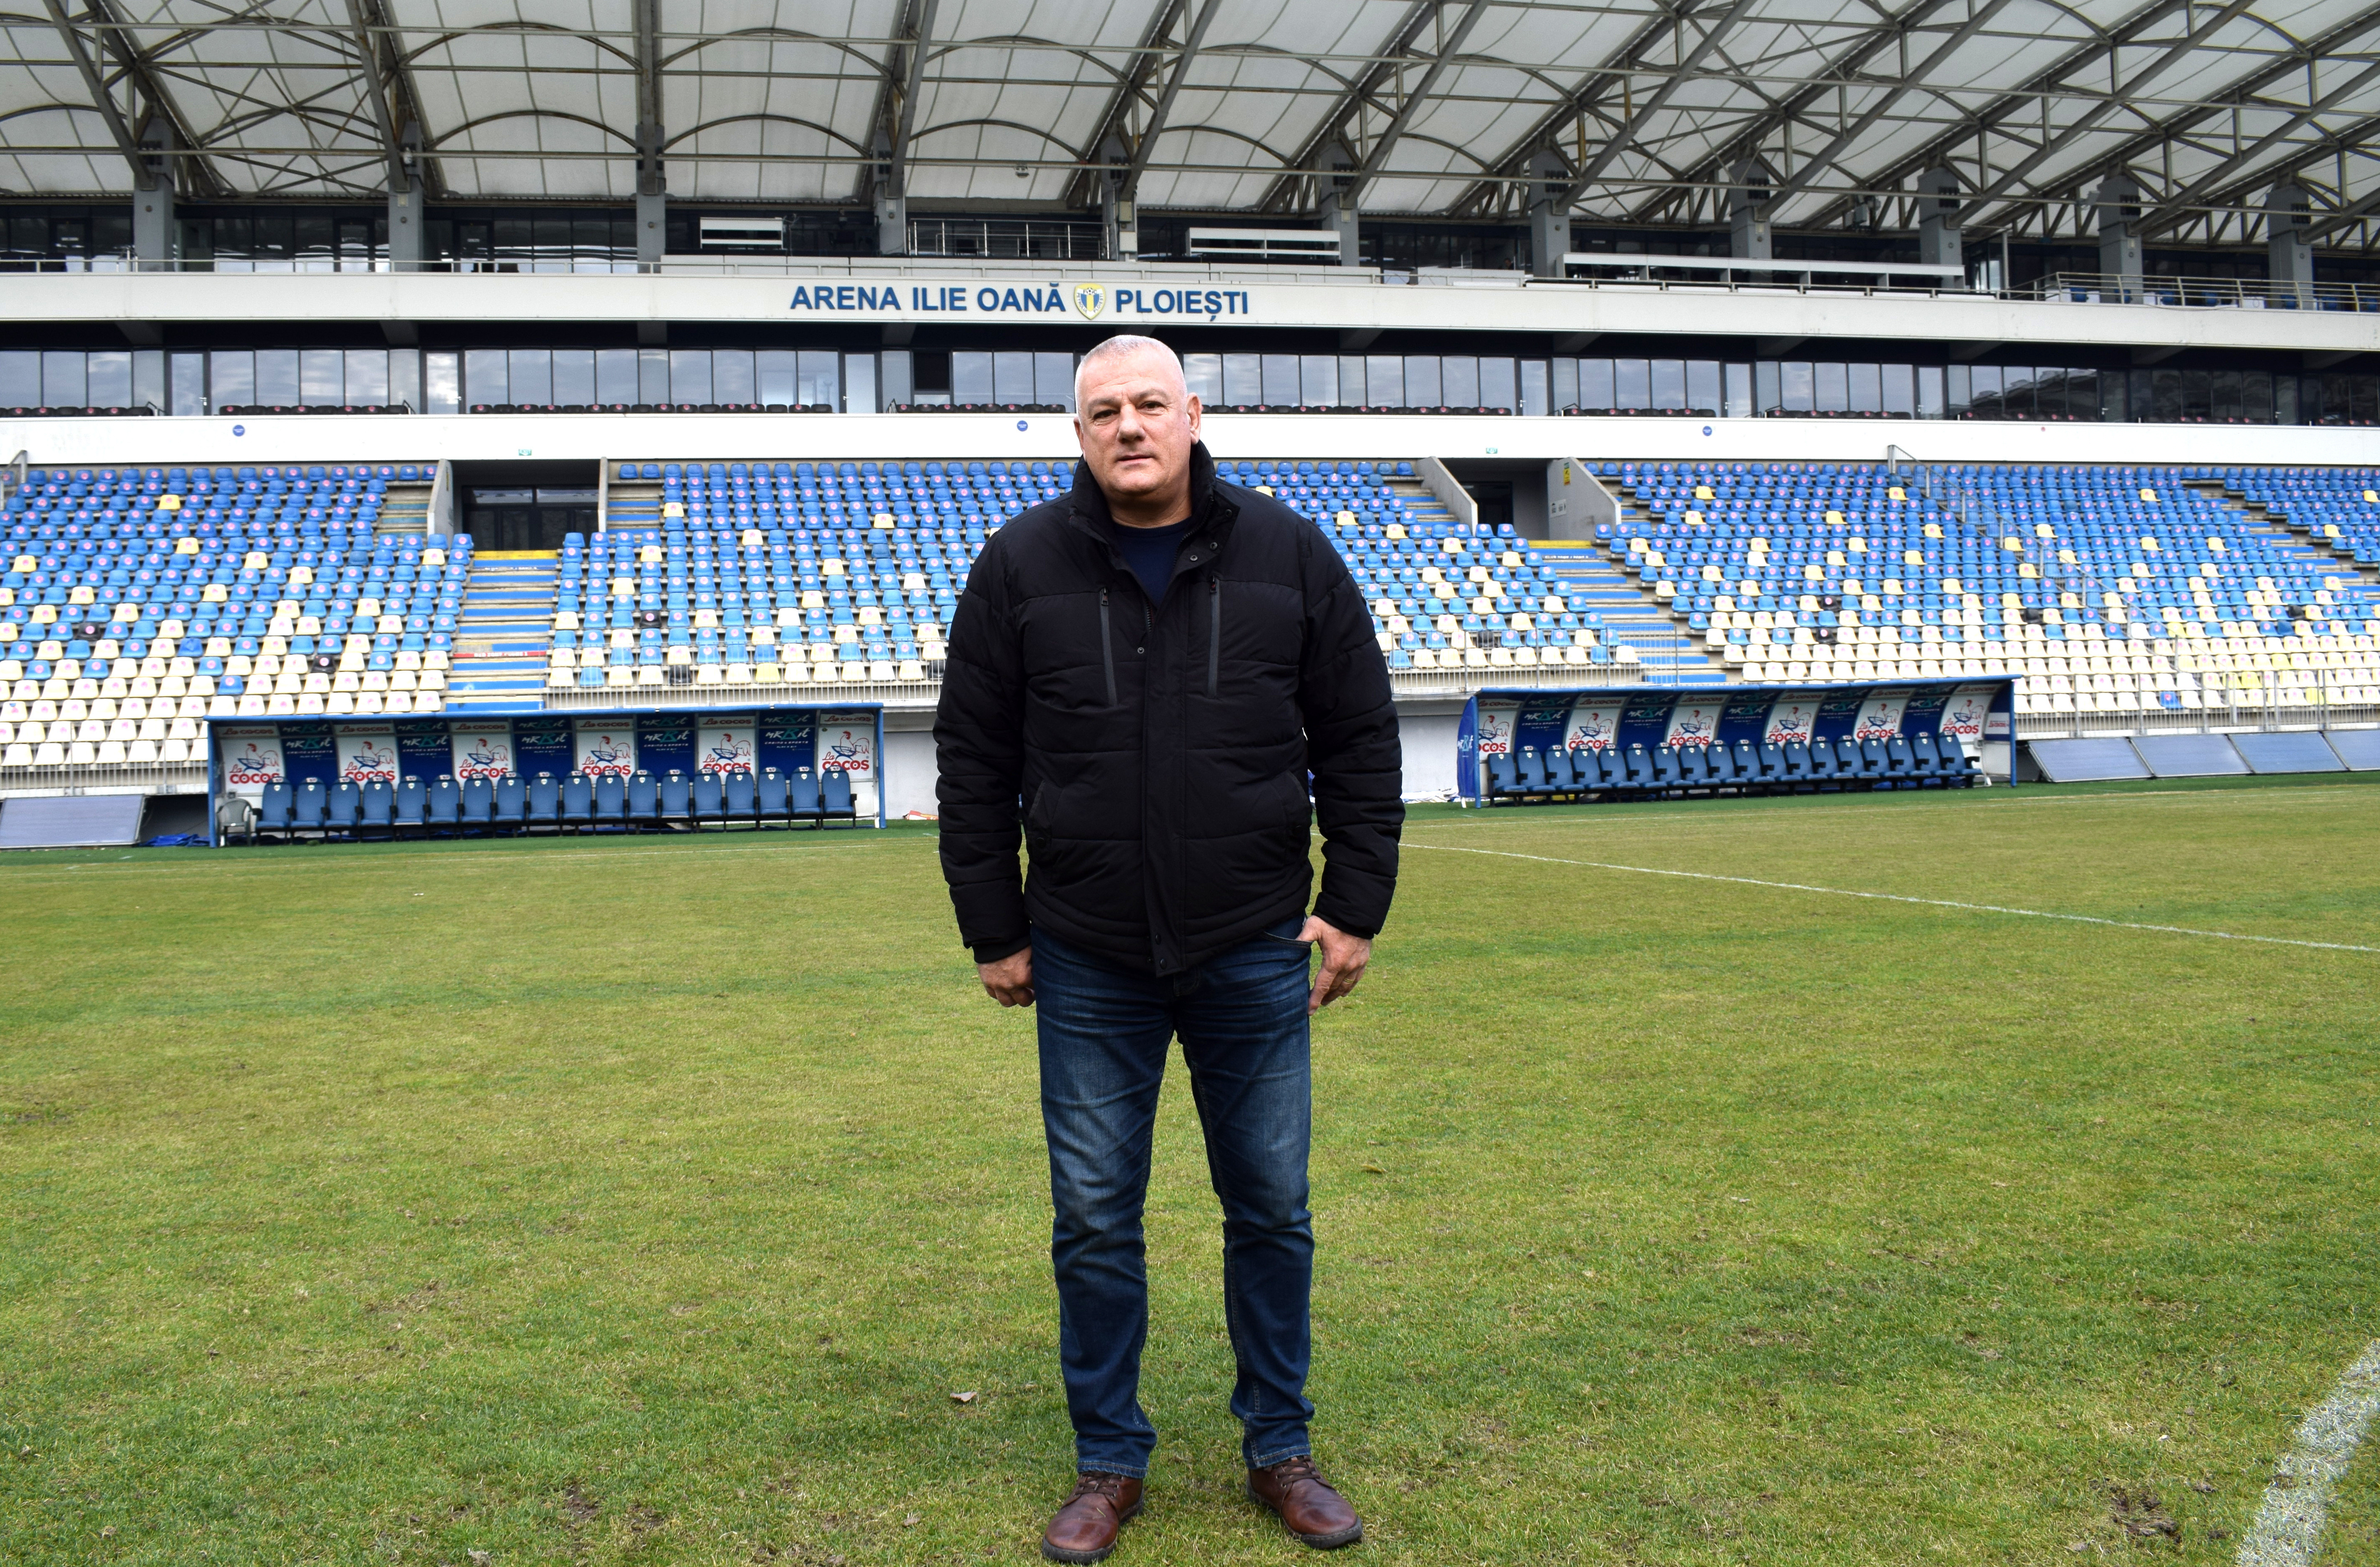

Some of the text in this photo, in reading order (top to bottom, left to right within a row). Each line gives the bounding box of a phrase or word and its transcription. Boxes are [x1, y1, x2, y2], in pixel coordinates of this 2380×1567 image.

[790, 282, 1248, 322] ARENA ILIE OANĂ PLOIEȘTI
[1479, 742, 1506, 752] COS
